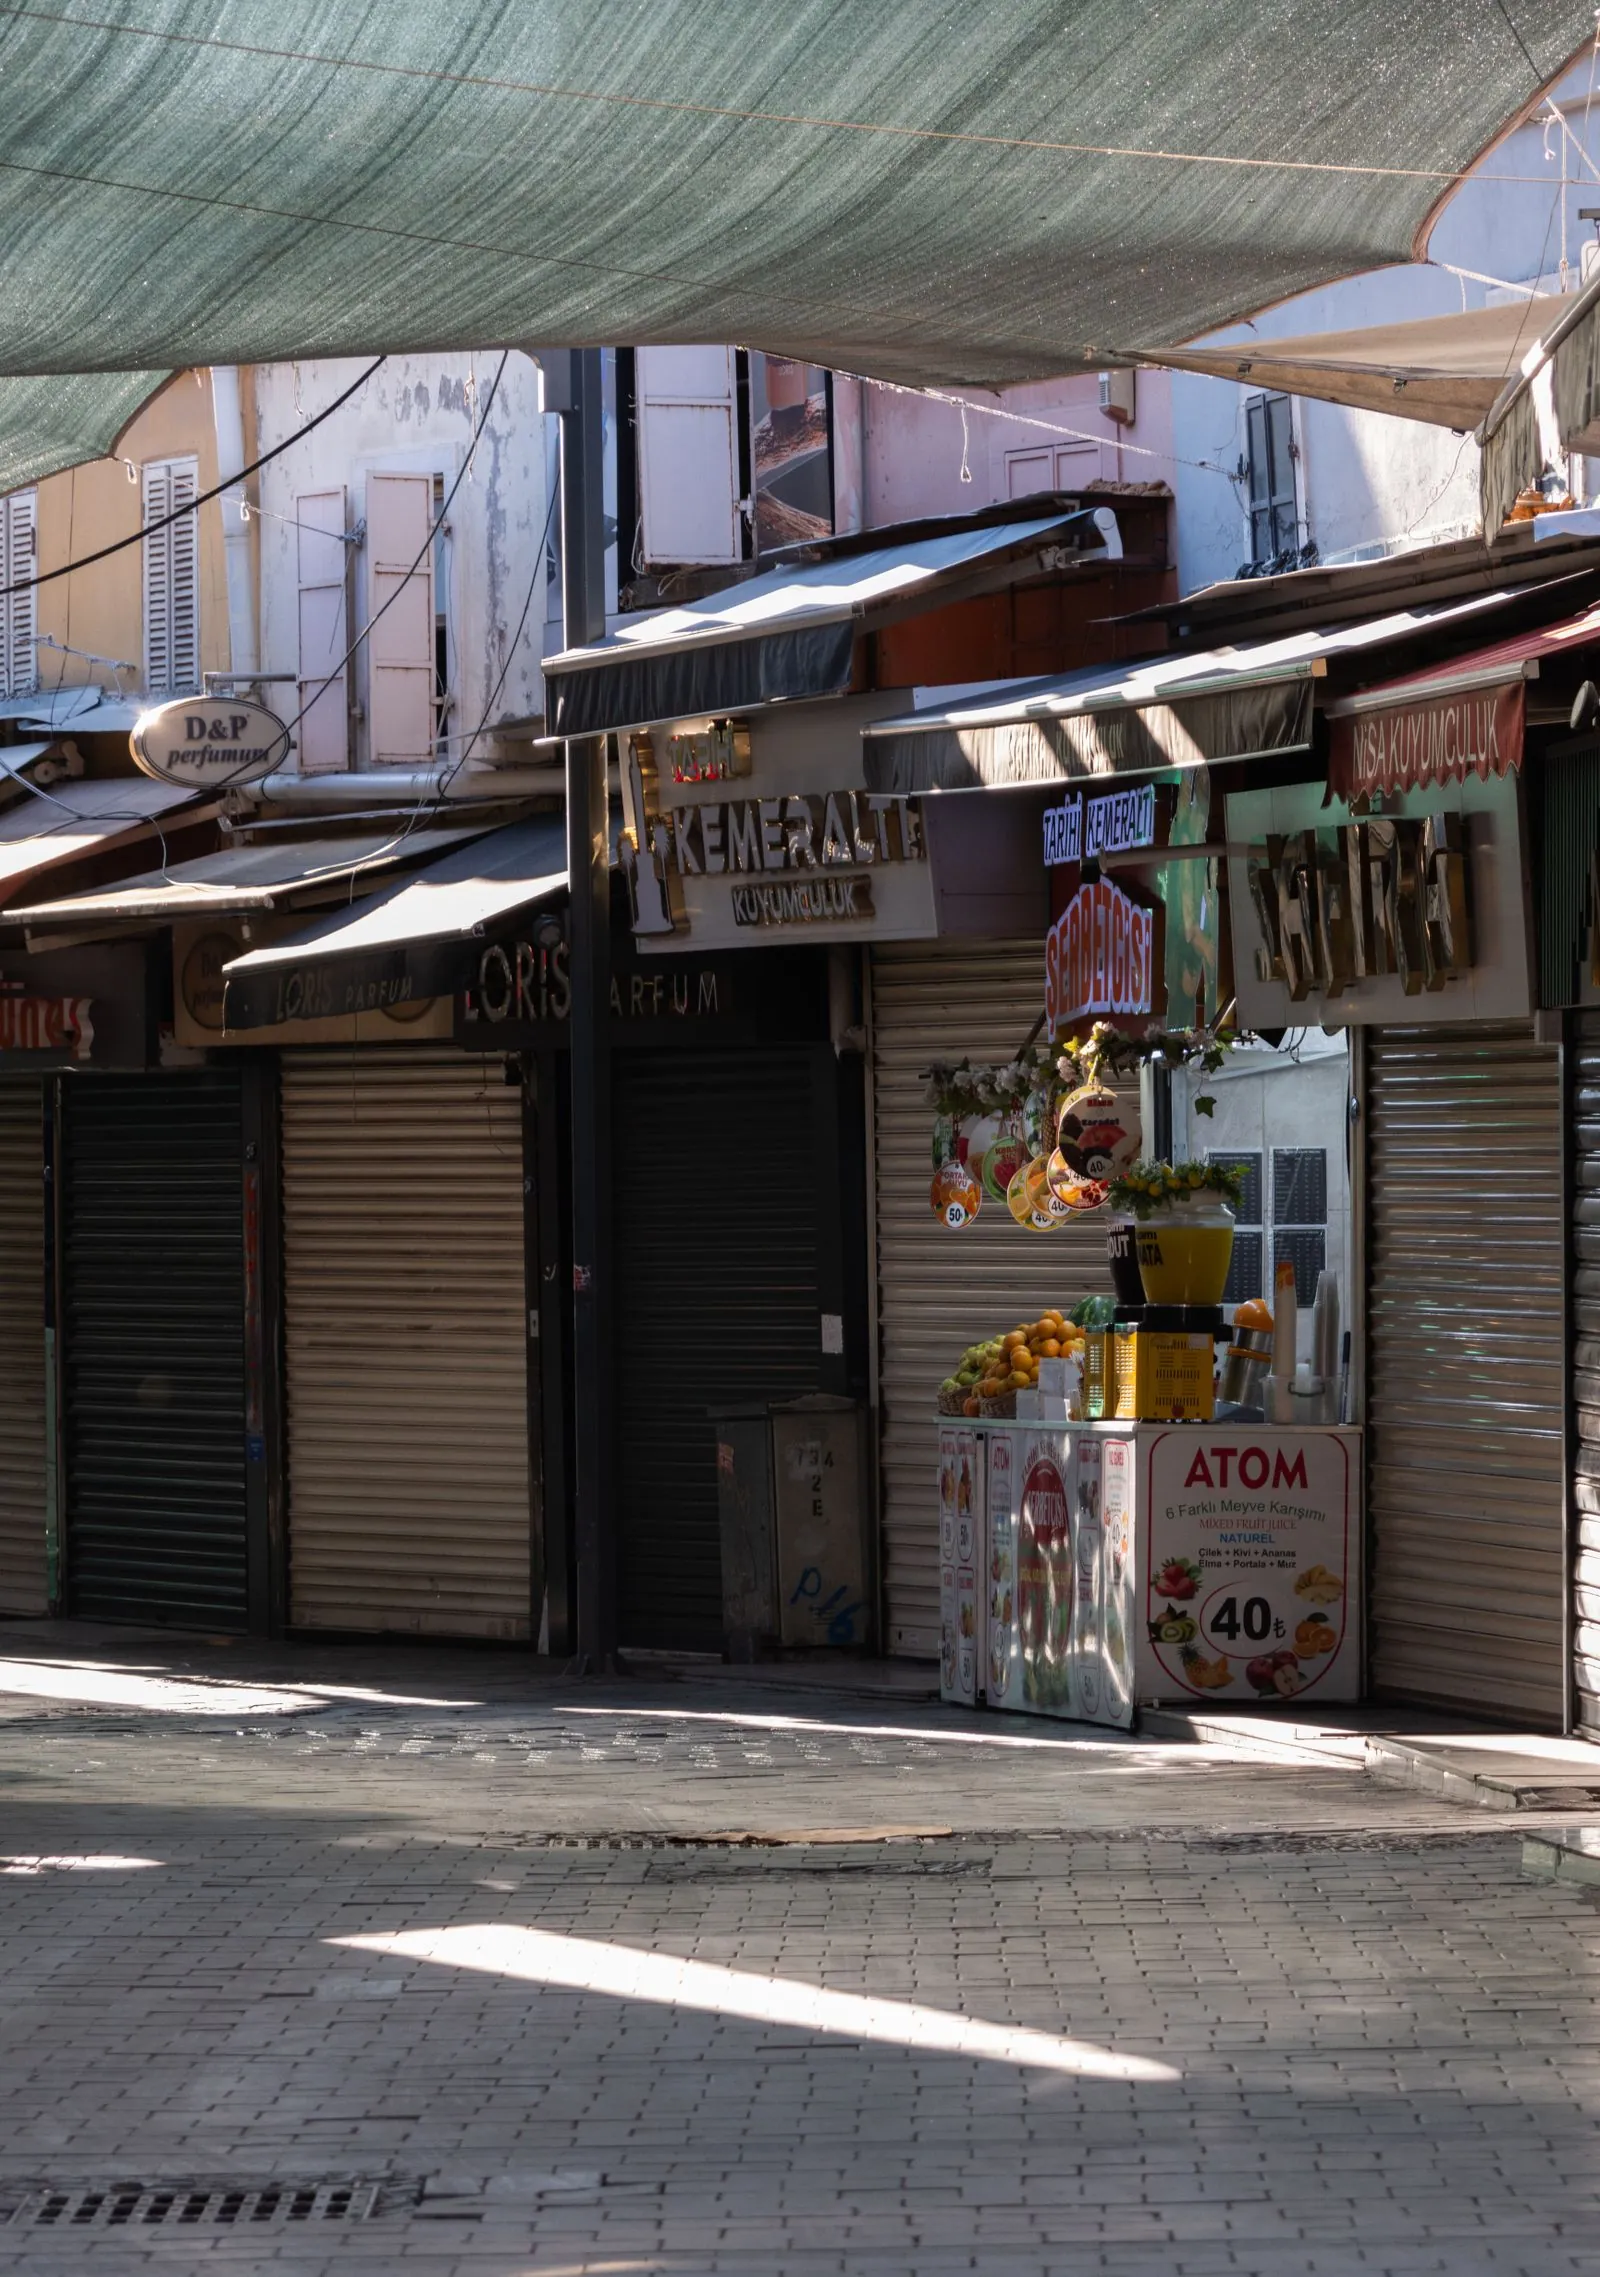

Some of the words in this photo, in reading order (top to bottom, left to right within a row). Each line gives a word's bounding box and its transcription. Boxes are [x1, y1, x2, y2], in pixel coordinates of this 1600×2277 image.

[185, 713, 249, 742] D&P
[1388, 699, 1499, 775] KUYUMCULUK
[672, 790, 912, 876] KEMERALTI
[1086, 788, 1154, 854] KEMERALTI
[733, 878, 860, 925] KUYUMCULUK
[609, 971, 719, 1018] ARFUM
[812, 1475, 821, 1492] 2
[1184, 1446, 1309, 1490] ATOM
[1165, 1508, 1175, 1521] 6
[1178, 1501, 1217, 1518] Farklı
[1221, 1500, 1266, 1515] Meyve
[1269, 1501, 1326, 1523] Karışımı
[1198, 1548, 1222, 1558] Çilek
[1233, 1548, 1251, 1557] Kivi
[1261, 1548, 1297, 1557] Ananas
[1219, 1532, 1276, 1544] NATUREL
[1198, 1560, 1222, 1569] Elma
[1277, 1560, 1297, 1569] Muz
